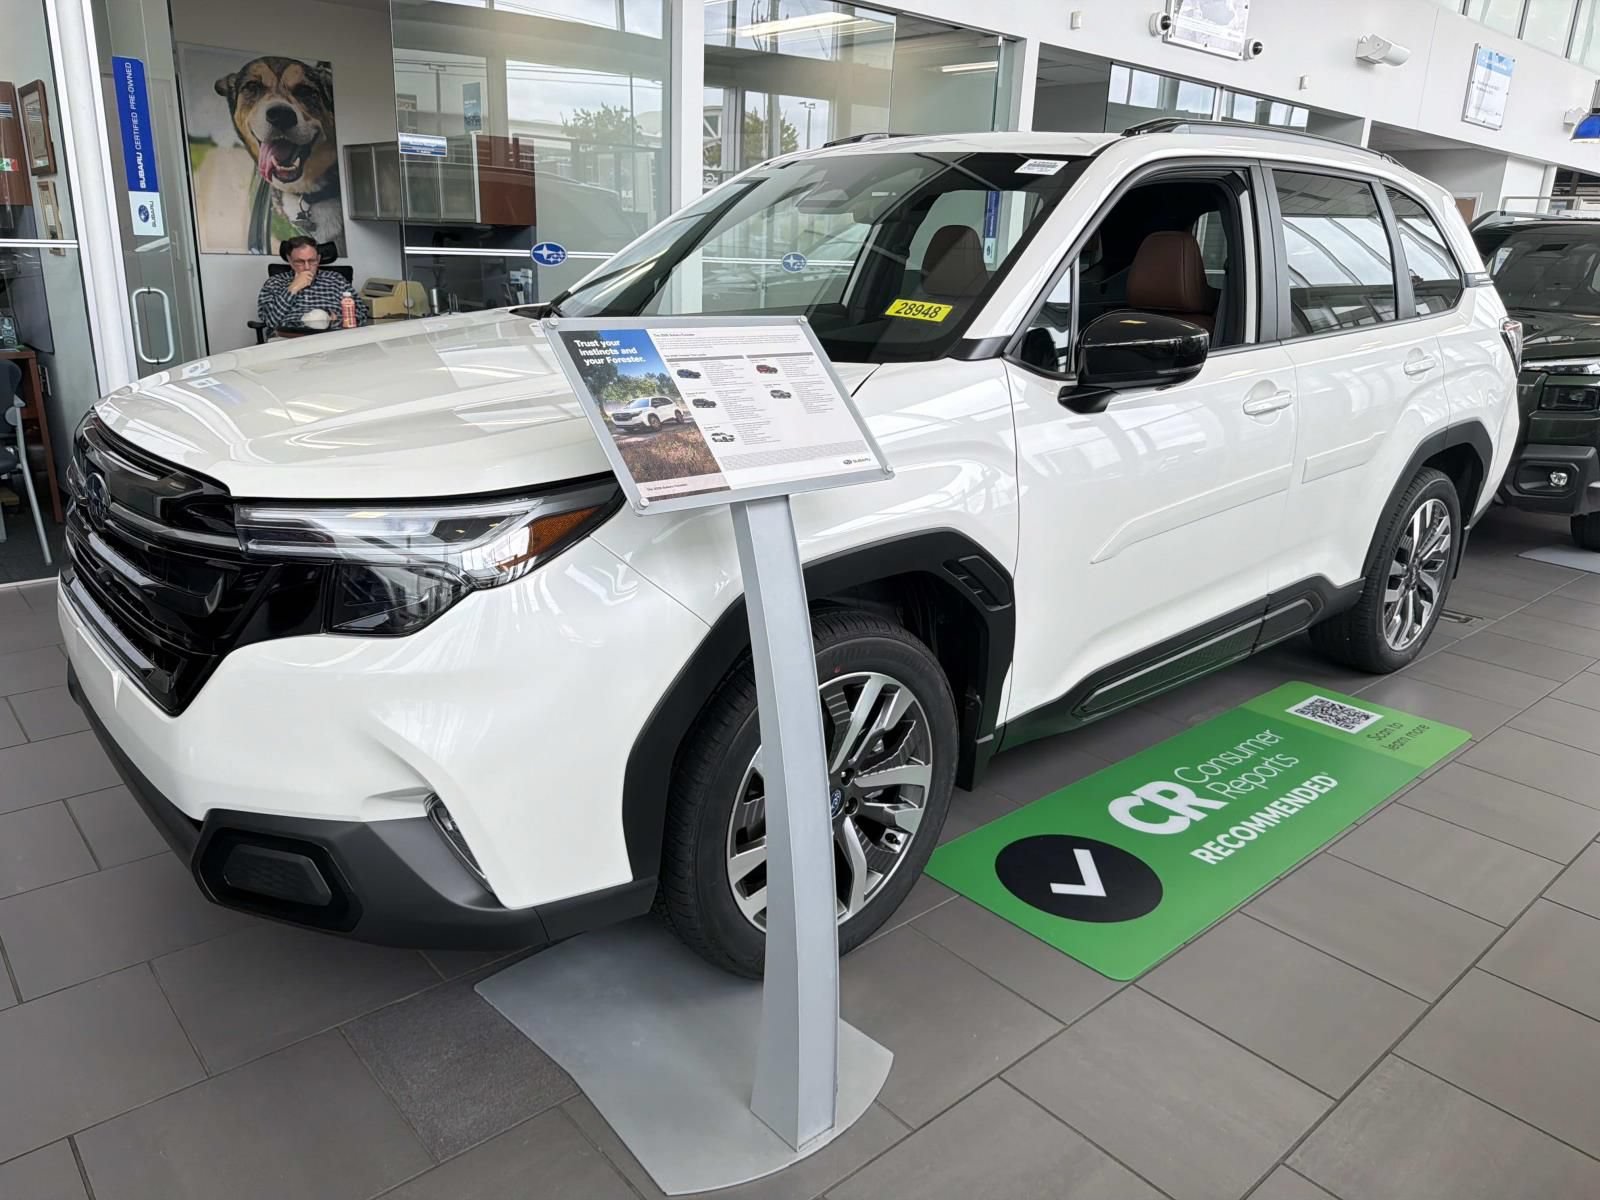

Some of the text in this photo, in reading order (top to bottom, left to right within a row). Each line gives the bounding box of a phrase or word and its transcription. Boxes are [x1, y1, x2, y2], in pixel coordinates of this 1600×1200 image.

[124, 62, 146, 189] SUBARU CERTIFIED PRE-OWNED
[895, 302, 942, 319] 28948
[600, 340, 620, 348] your
[621, 347, 638, 355] and
[583, 356, 646, 366] your Forester.
[1366, 727, 1395, 741] Scan
[1381, 724, 1431, 751] learn more
[1174, 729, 1284, 784] Consumer
[1205, 753, 1300, 800] Reports
[1107, 780, 1230, 835] CR
[1190, 774, 1339, 865] RECOMMENDED
